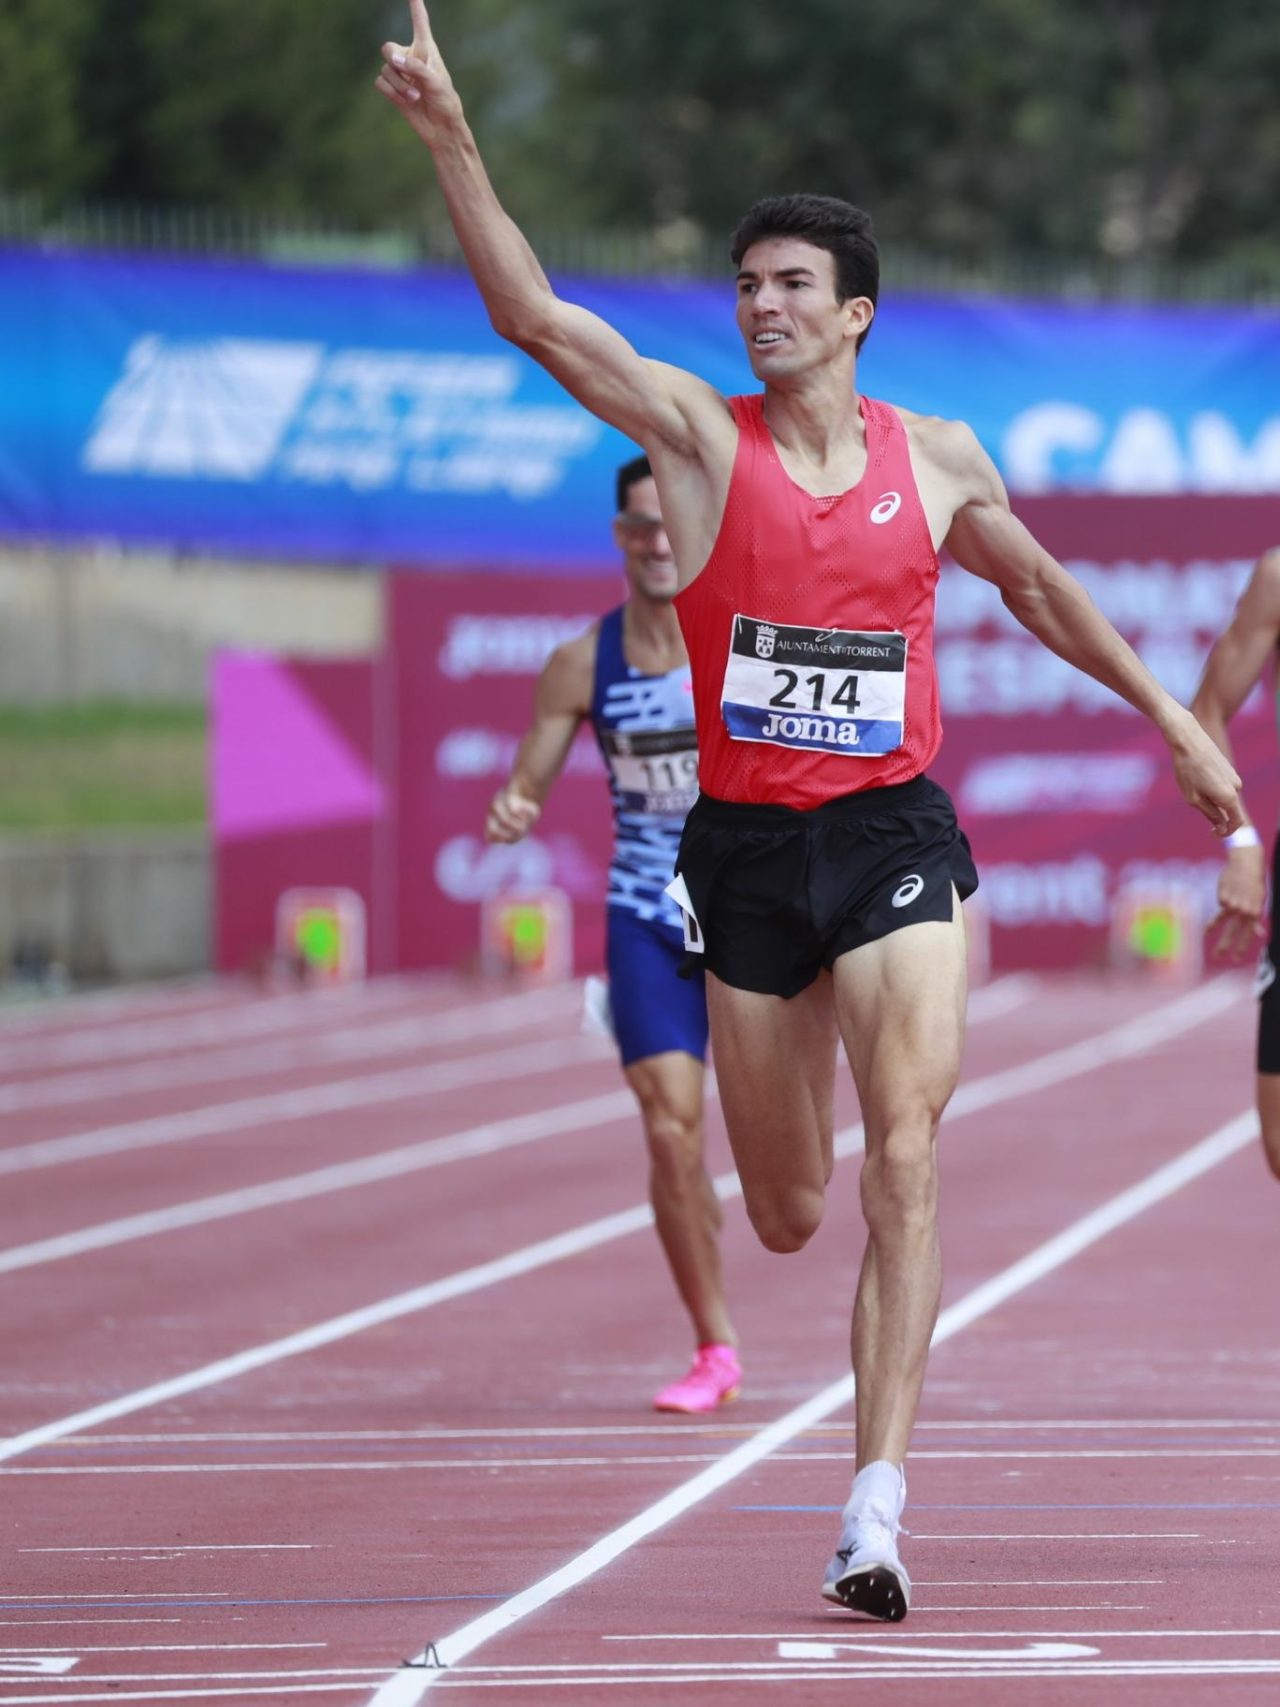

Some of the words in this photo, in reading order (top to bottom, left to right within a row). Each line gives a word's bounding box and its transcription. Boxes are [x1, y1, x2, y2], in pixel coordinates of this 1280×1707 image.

[845, 645, 891, 658] TORRENT
[769, 668, 860, 715] 214
[761, 713, 861, 746] Joma
